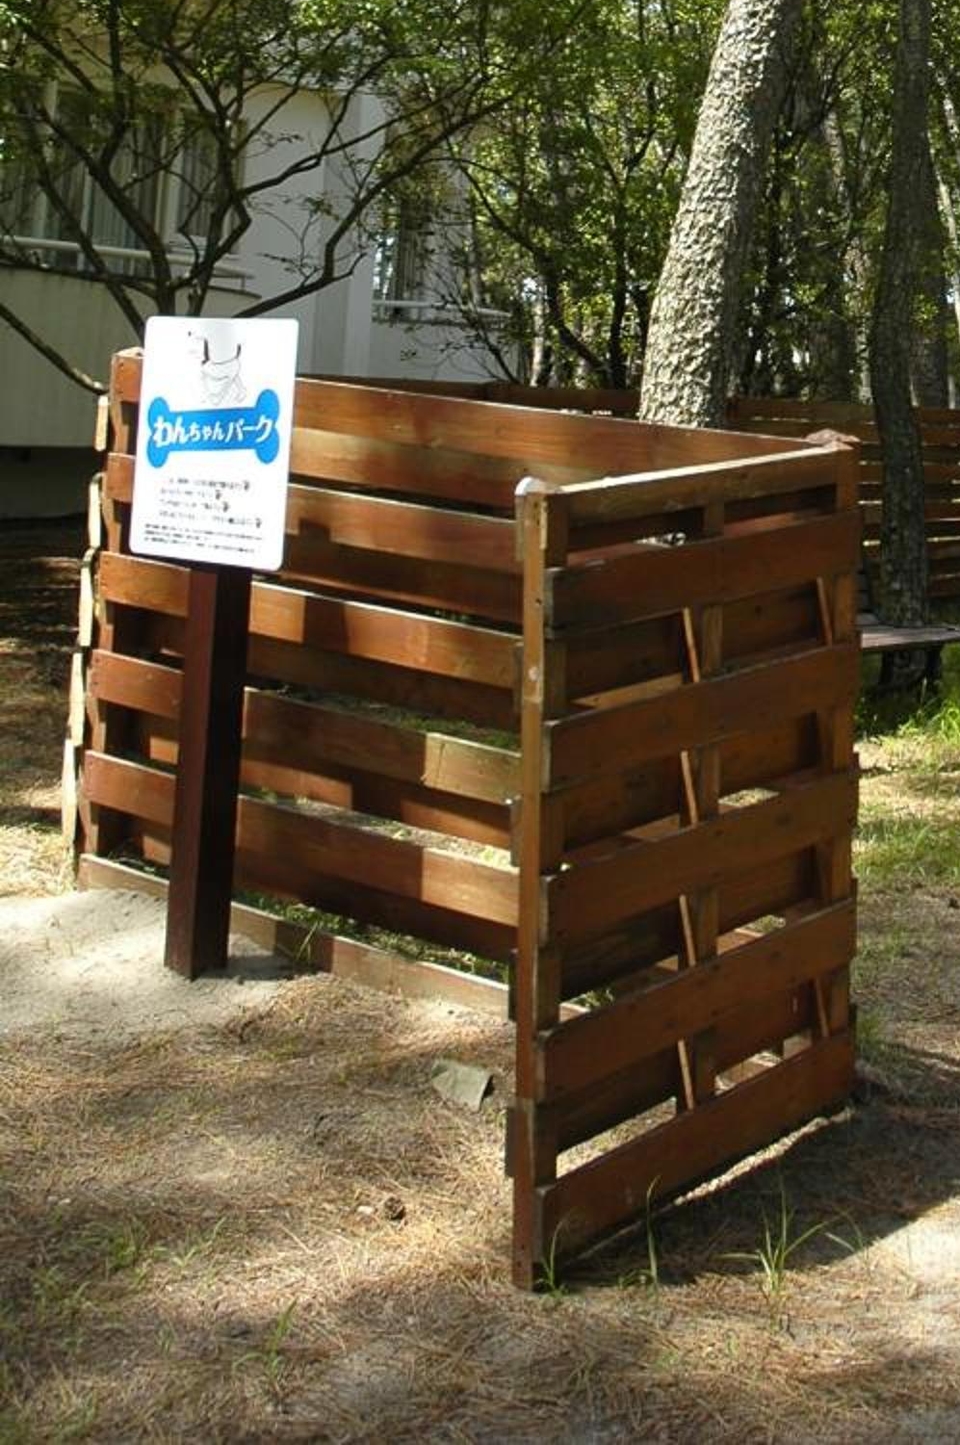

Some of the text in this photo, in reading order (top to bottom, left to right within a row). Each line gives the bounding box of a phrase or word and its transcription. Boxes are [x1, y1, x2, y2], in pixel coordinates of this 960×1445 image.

[153, 415, 272, 448] わんちゃんパーク
